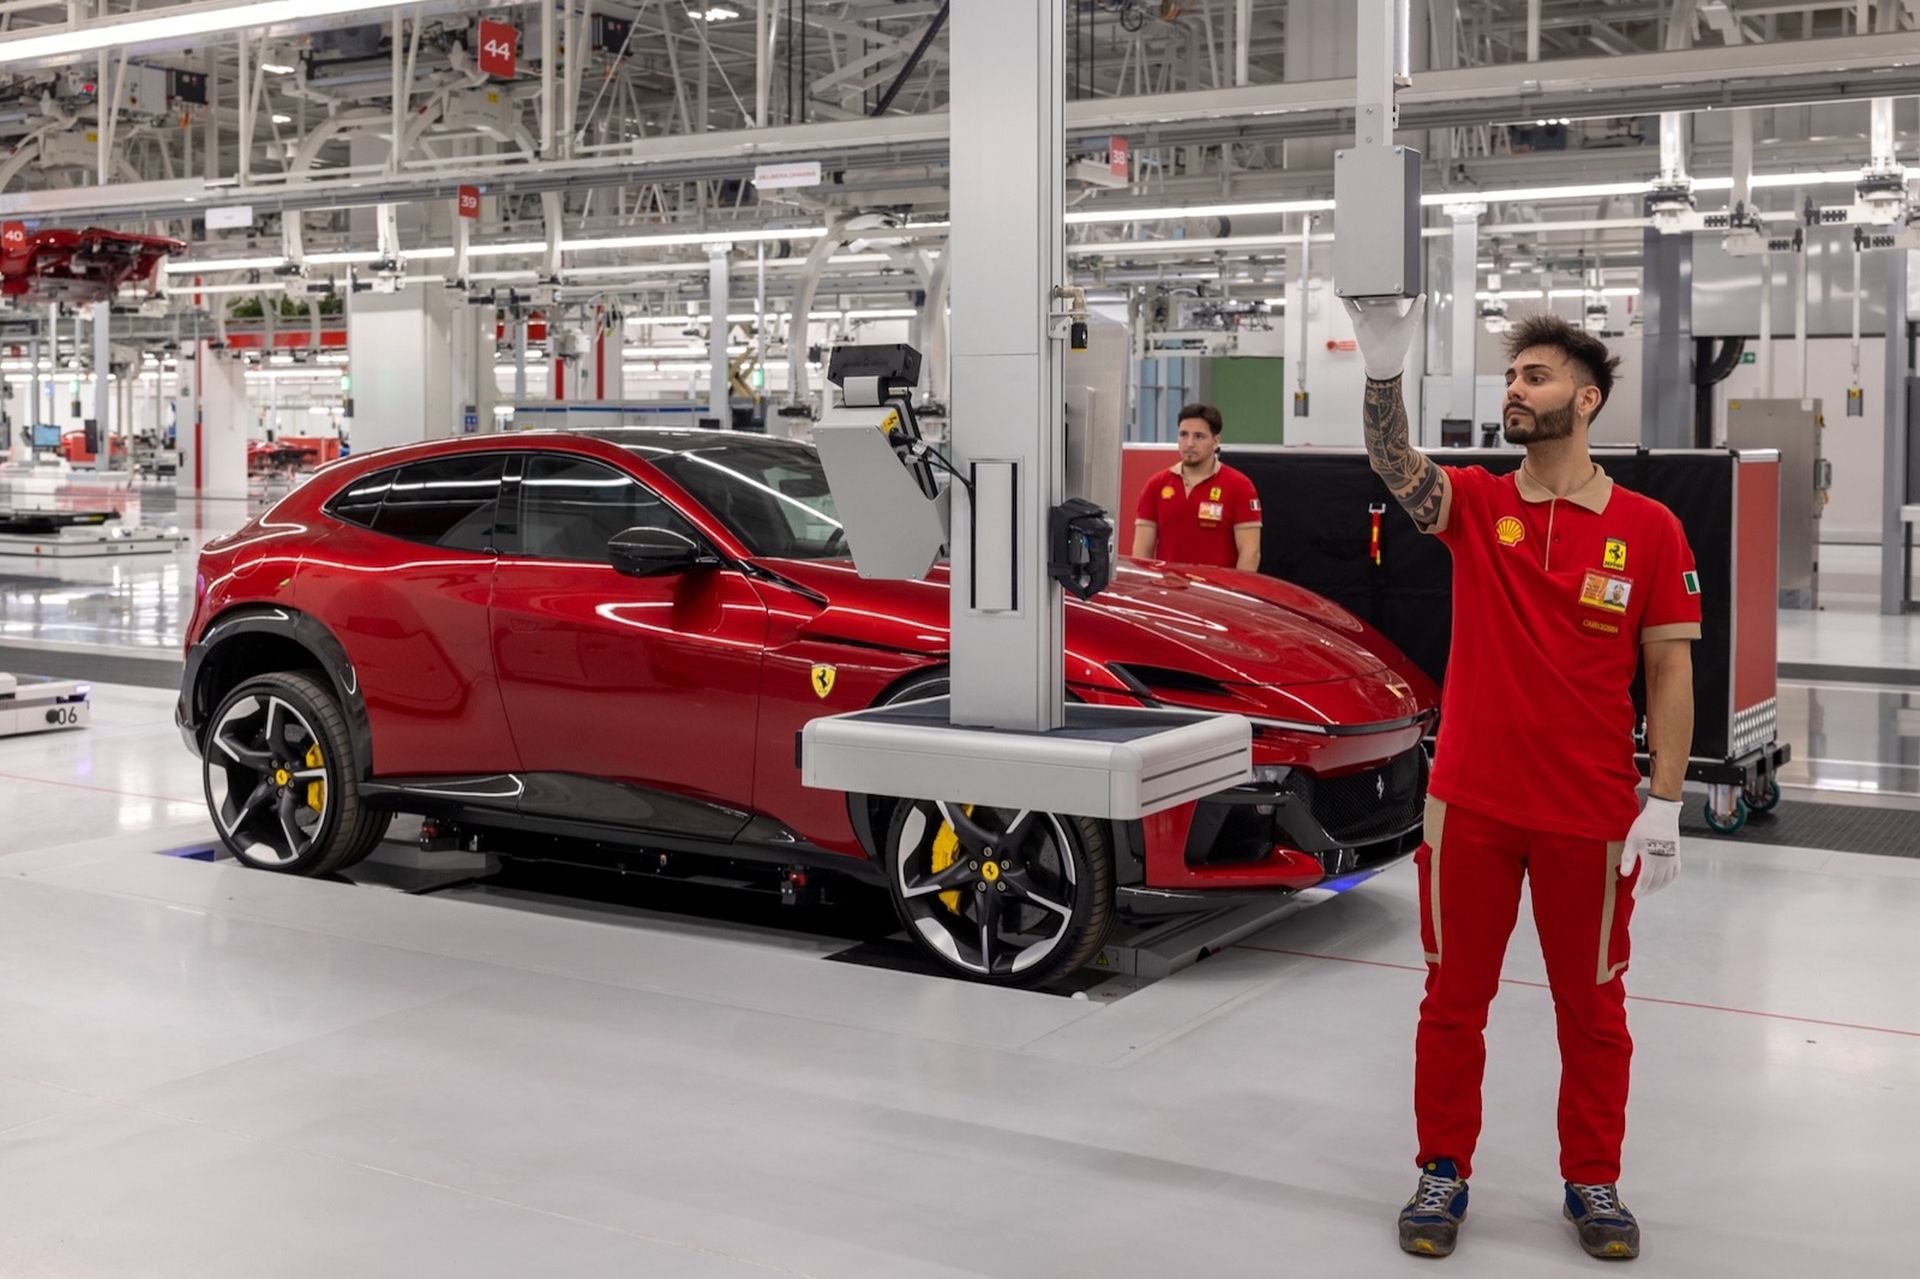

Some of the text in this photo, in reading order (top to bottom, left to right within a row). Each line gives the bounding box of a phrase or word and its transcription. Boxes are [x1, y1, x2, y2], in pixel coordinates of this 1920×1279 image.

[484, 39, 510, 60] 44
[1113, 150, 1125, 165] 38
[461, 195, 477, 208] 39
[5, 230, 23, 241] 40
[58, 706, 77, 725] 06
